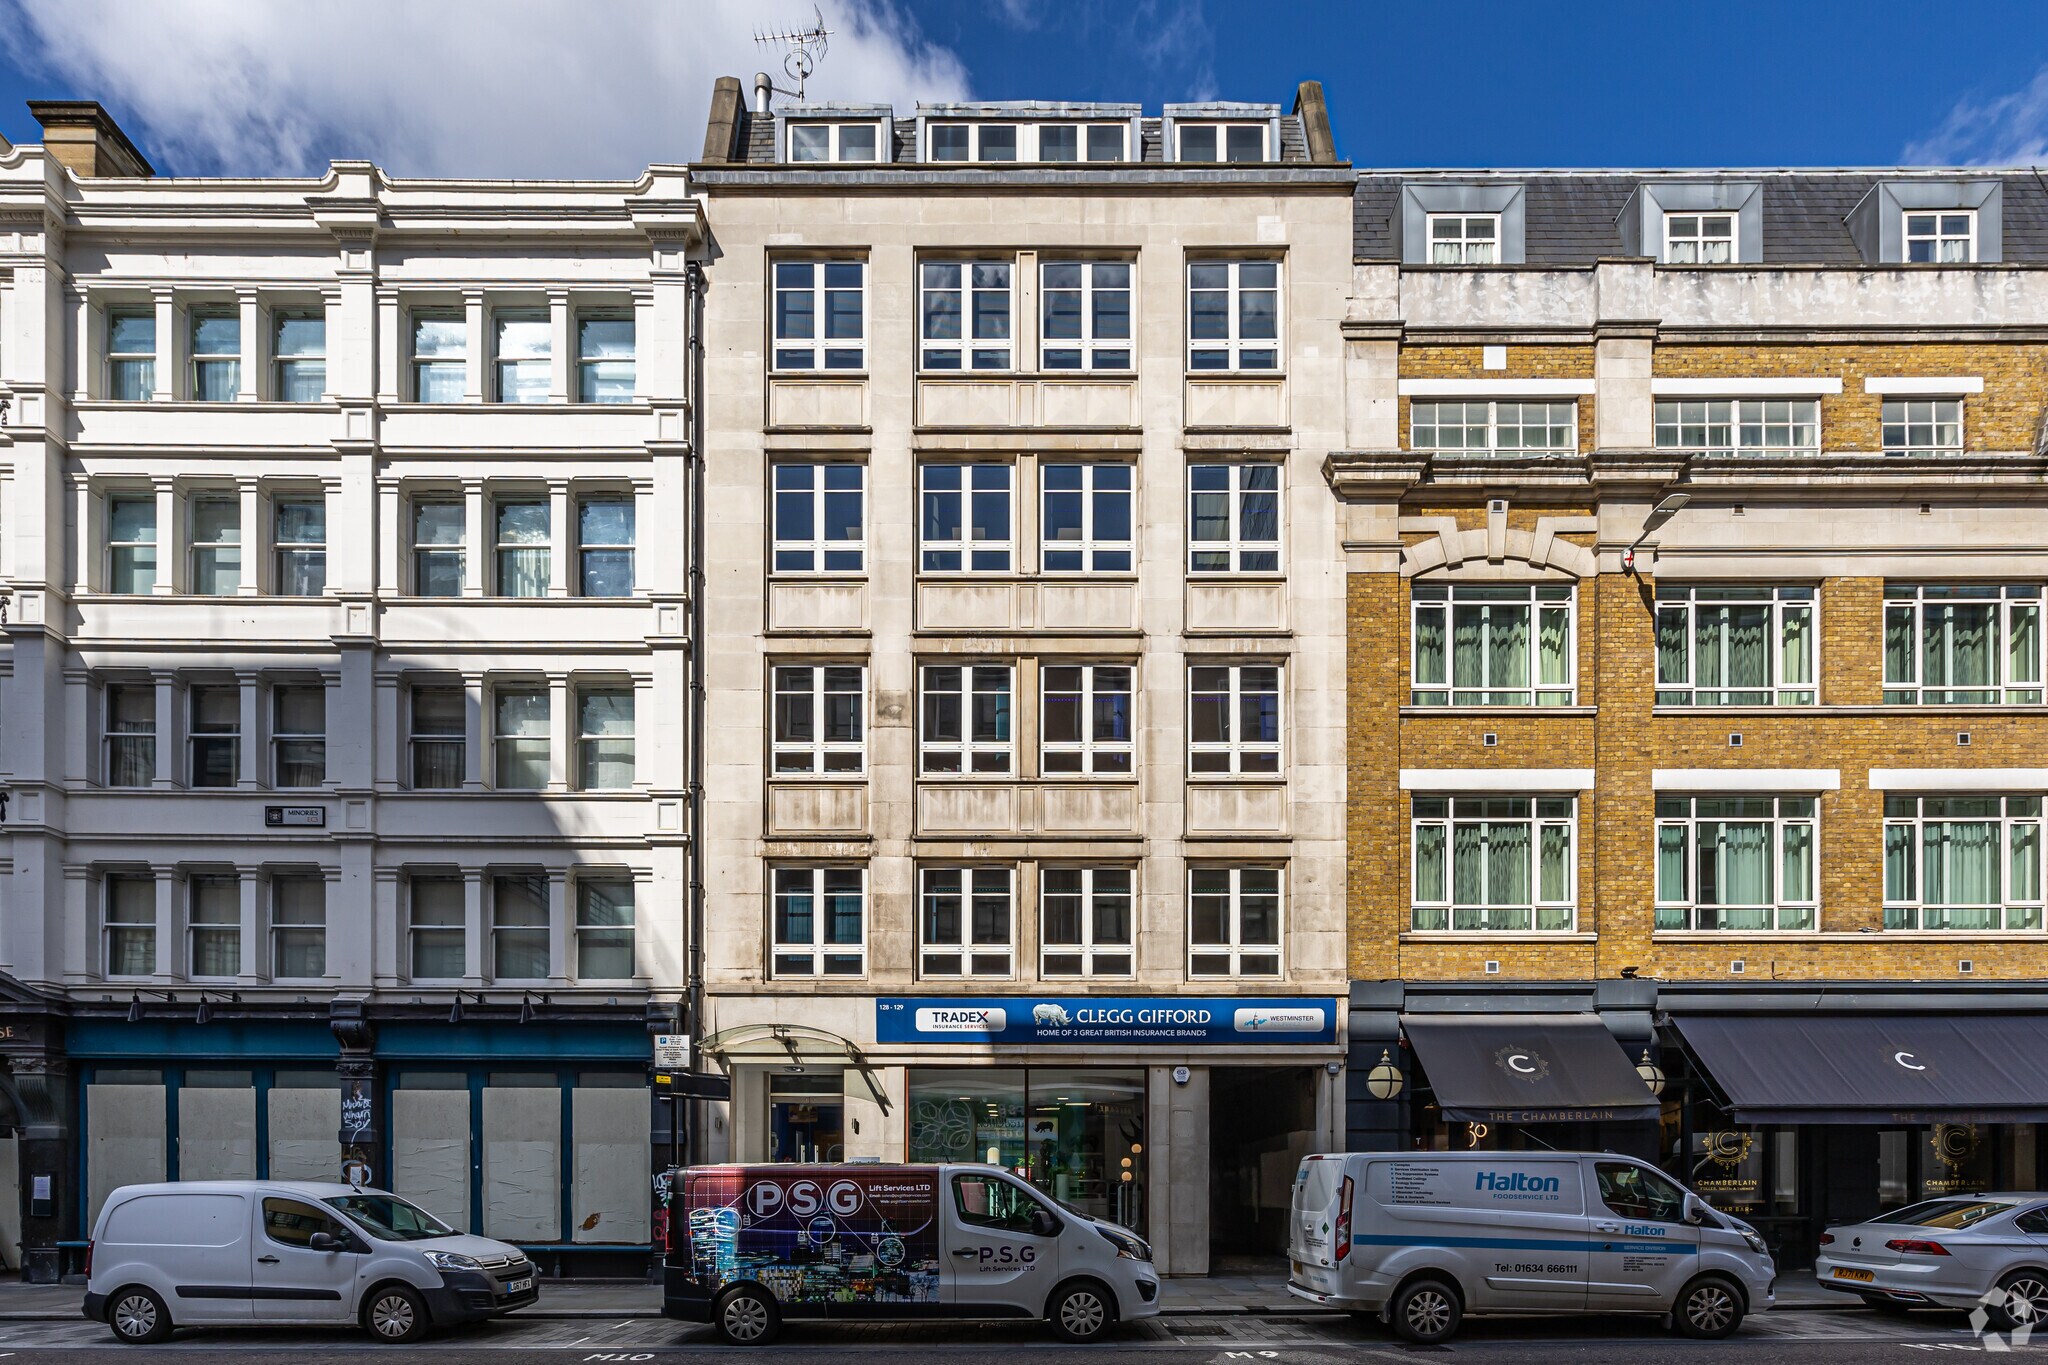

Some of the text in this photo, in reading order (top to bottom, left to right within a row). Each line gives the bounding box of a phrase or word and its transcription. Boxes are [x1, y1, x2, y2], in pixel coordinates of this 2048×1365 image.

[932, 1011, 988, 1023] TRADEX
[1077, 1009, 1211, 1023] CLEGG GIFFORD
[1507, 1054, 1536, 1073] C
[1895, 1051, 1926, 1071] C
[1489, 1111, 1613, 1121] THE CHAMBERLAIN
[1892, 1113, 2017, 1122] THE CHAMBERLAIN
[1715, 1129, 1739, 1155] C
[1943, 1128, 1967, 1155] C
[1475, 1172, 1559, 1192] Halton
[1493, 1193, 1544, 1201] FOODSERVICE
[1624, 1225, 1665, 1236] Halton
[979, 1246, 1036, 1263] P.S.G
[1495, 1263, 1578, 1273] Tel: 01634 666111
